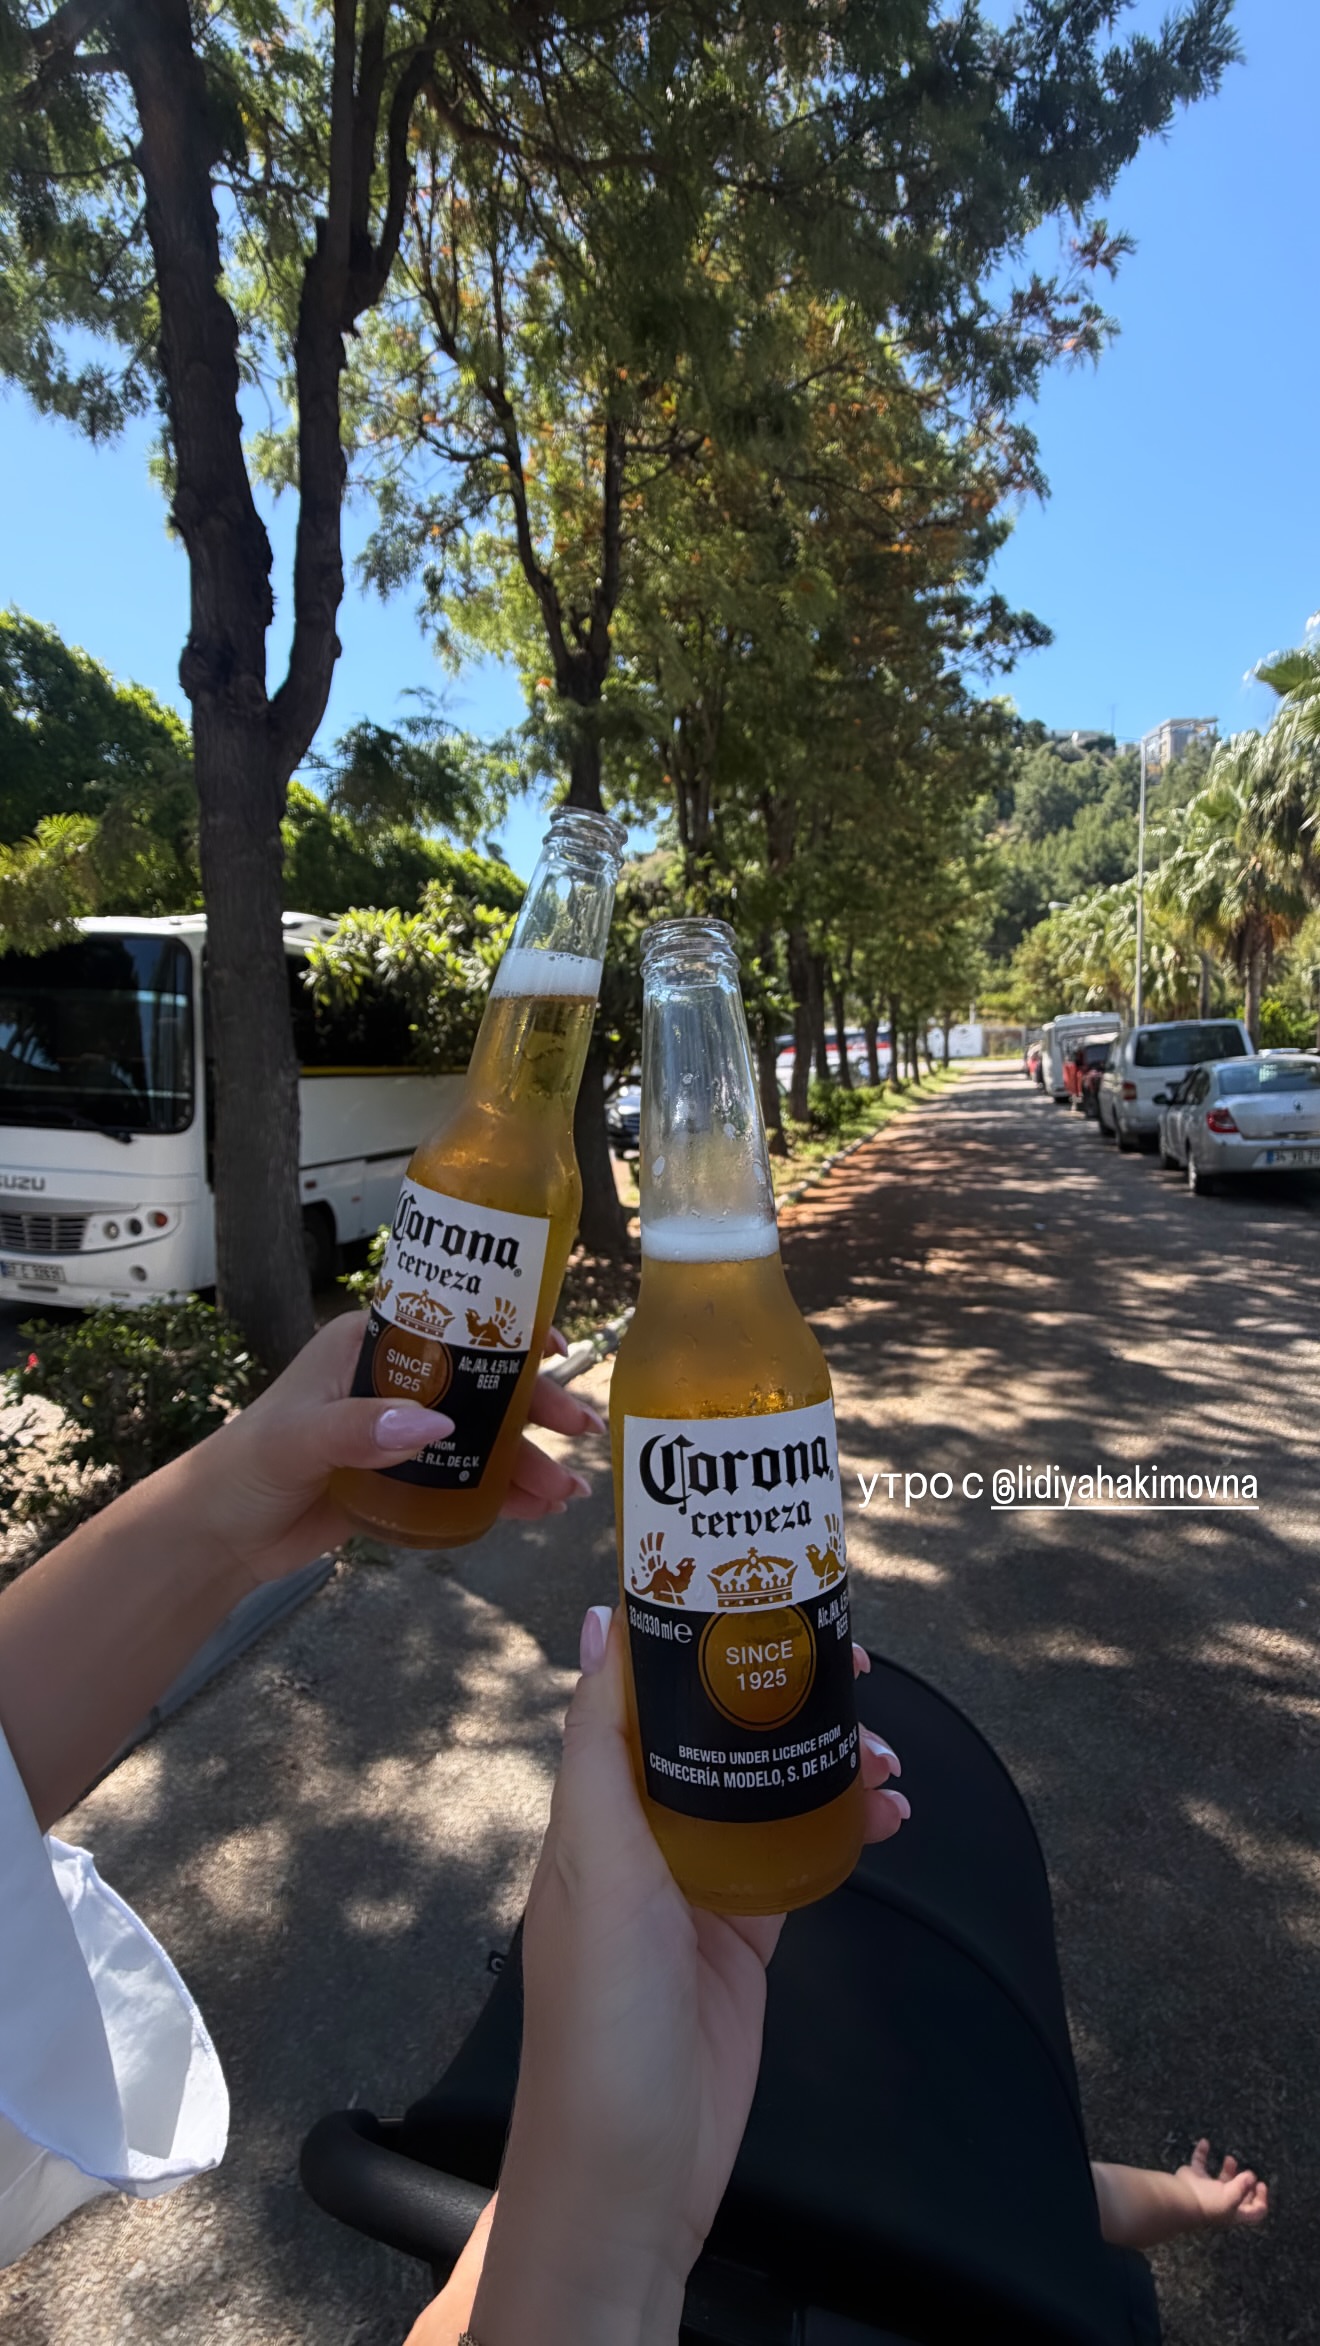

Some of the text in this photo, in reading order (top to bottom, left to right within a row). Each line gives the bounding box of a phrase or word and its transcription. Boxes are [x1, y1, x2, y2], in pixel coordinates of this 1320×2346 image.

[392, 1190, 521, 1270] Corona
[397, 1250, 482, 1296] cerveza
[386, 1348, 433, 1377] SINCE
[387, 1369, 422, 1392] 1925
[476, 1374, 500, 1389] BEER
[410, 1450, 425, 1464] E
[447, 1455, 462, 1468] DE
[462, 1456, 480, 1468] C.V.
[639, 1434, 831, 1516] Corona
[690, 1500, 813, 1538] cerveza
[726, 1639, 794, 1665] SINCE
[737, 1668, 788, 1691] 1925
[678, 1724, 842, 1765] BREWED UNDER LICENCE FROM
[649, 1752, 721, 1787] CERVECERÍA
[723, 1768, 785, 1788] MODELO,
[787, 1765, 800, 1783] S.
[802, 1758, 819, 1779] DE
[820, 1750, 839, 1772] R.L.
[839, 1738, 849, 1760] DE
